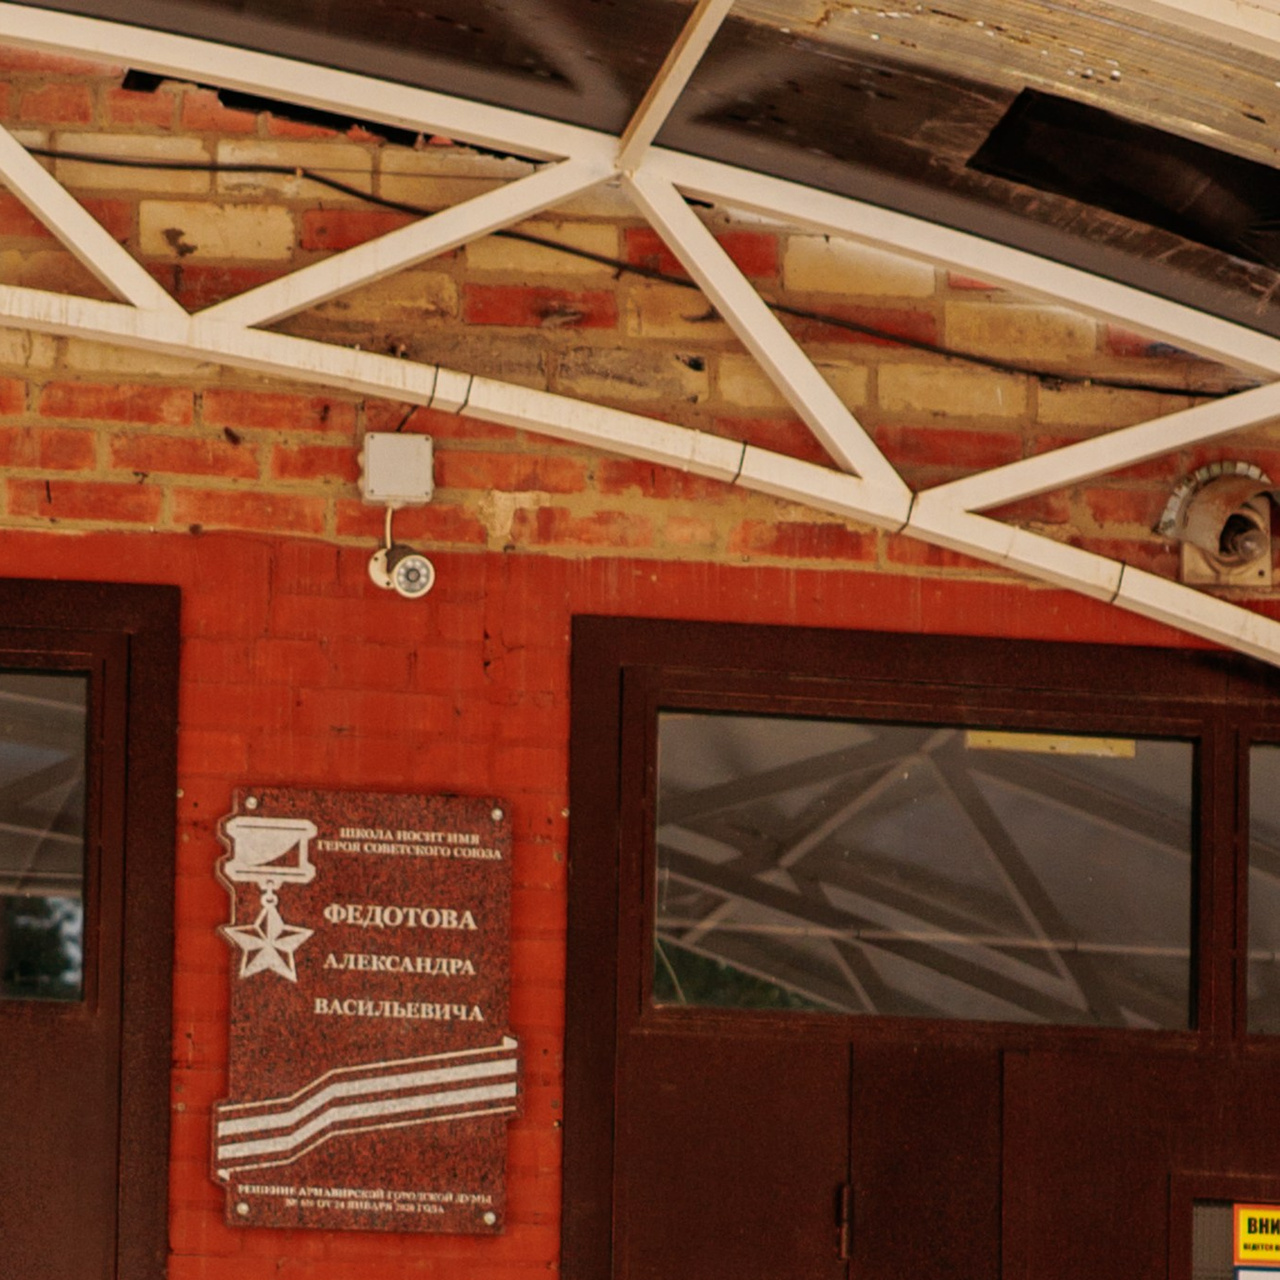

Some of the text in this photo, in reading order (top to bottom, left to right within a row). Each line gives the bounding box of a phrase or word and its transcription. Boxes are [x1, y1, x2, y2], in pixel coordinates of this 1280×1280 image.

[340, 827, 480, 844] ШКОЛА НОСИТ ИМЯ
[317, 840, 502, 860] ГЕРОЯ СОВЕТСКОГО СОЮЗА
[323, 903, 478, 931] ФЕДОТОВА
[323, 953, 476, 976] АЛЕКСАНДРА
[313, 997, 484, 1022] ВАСИЛЬЕВИЧА
[238, 1184, 493, 1205] РЕШЕНИЕ АРМАВИРСКОЙ ГОРОДСКОЙ ДУМЫ
[347, 1200, 392, 1211] ЯНВАРЯ
[417, 1203, 445, 1214] ГОДА
